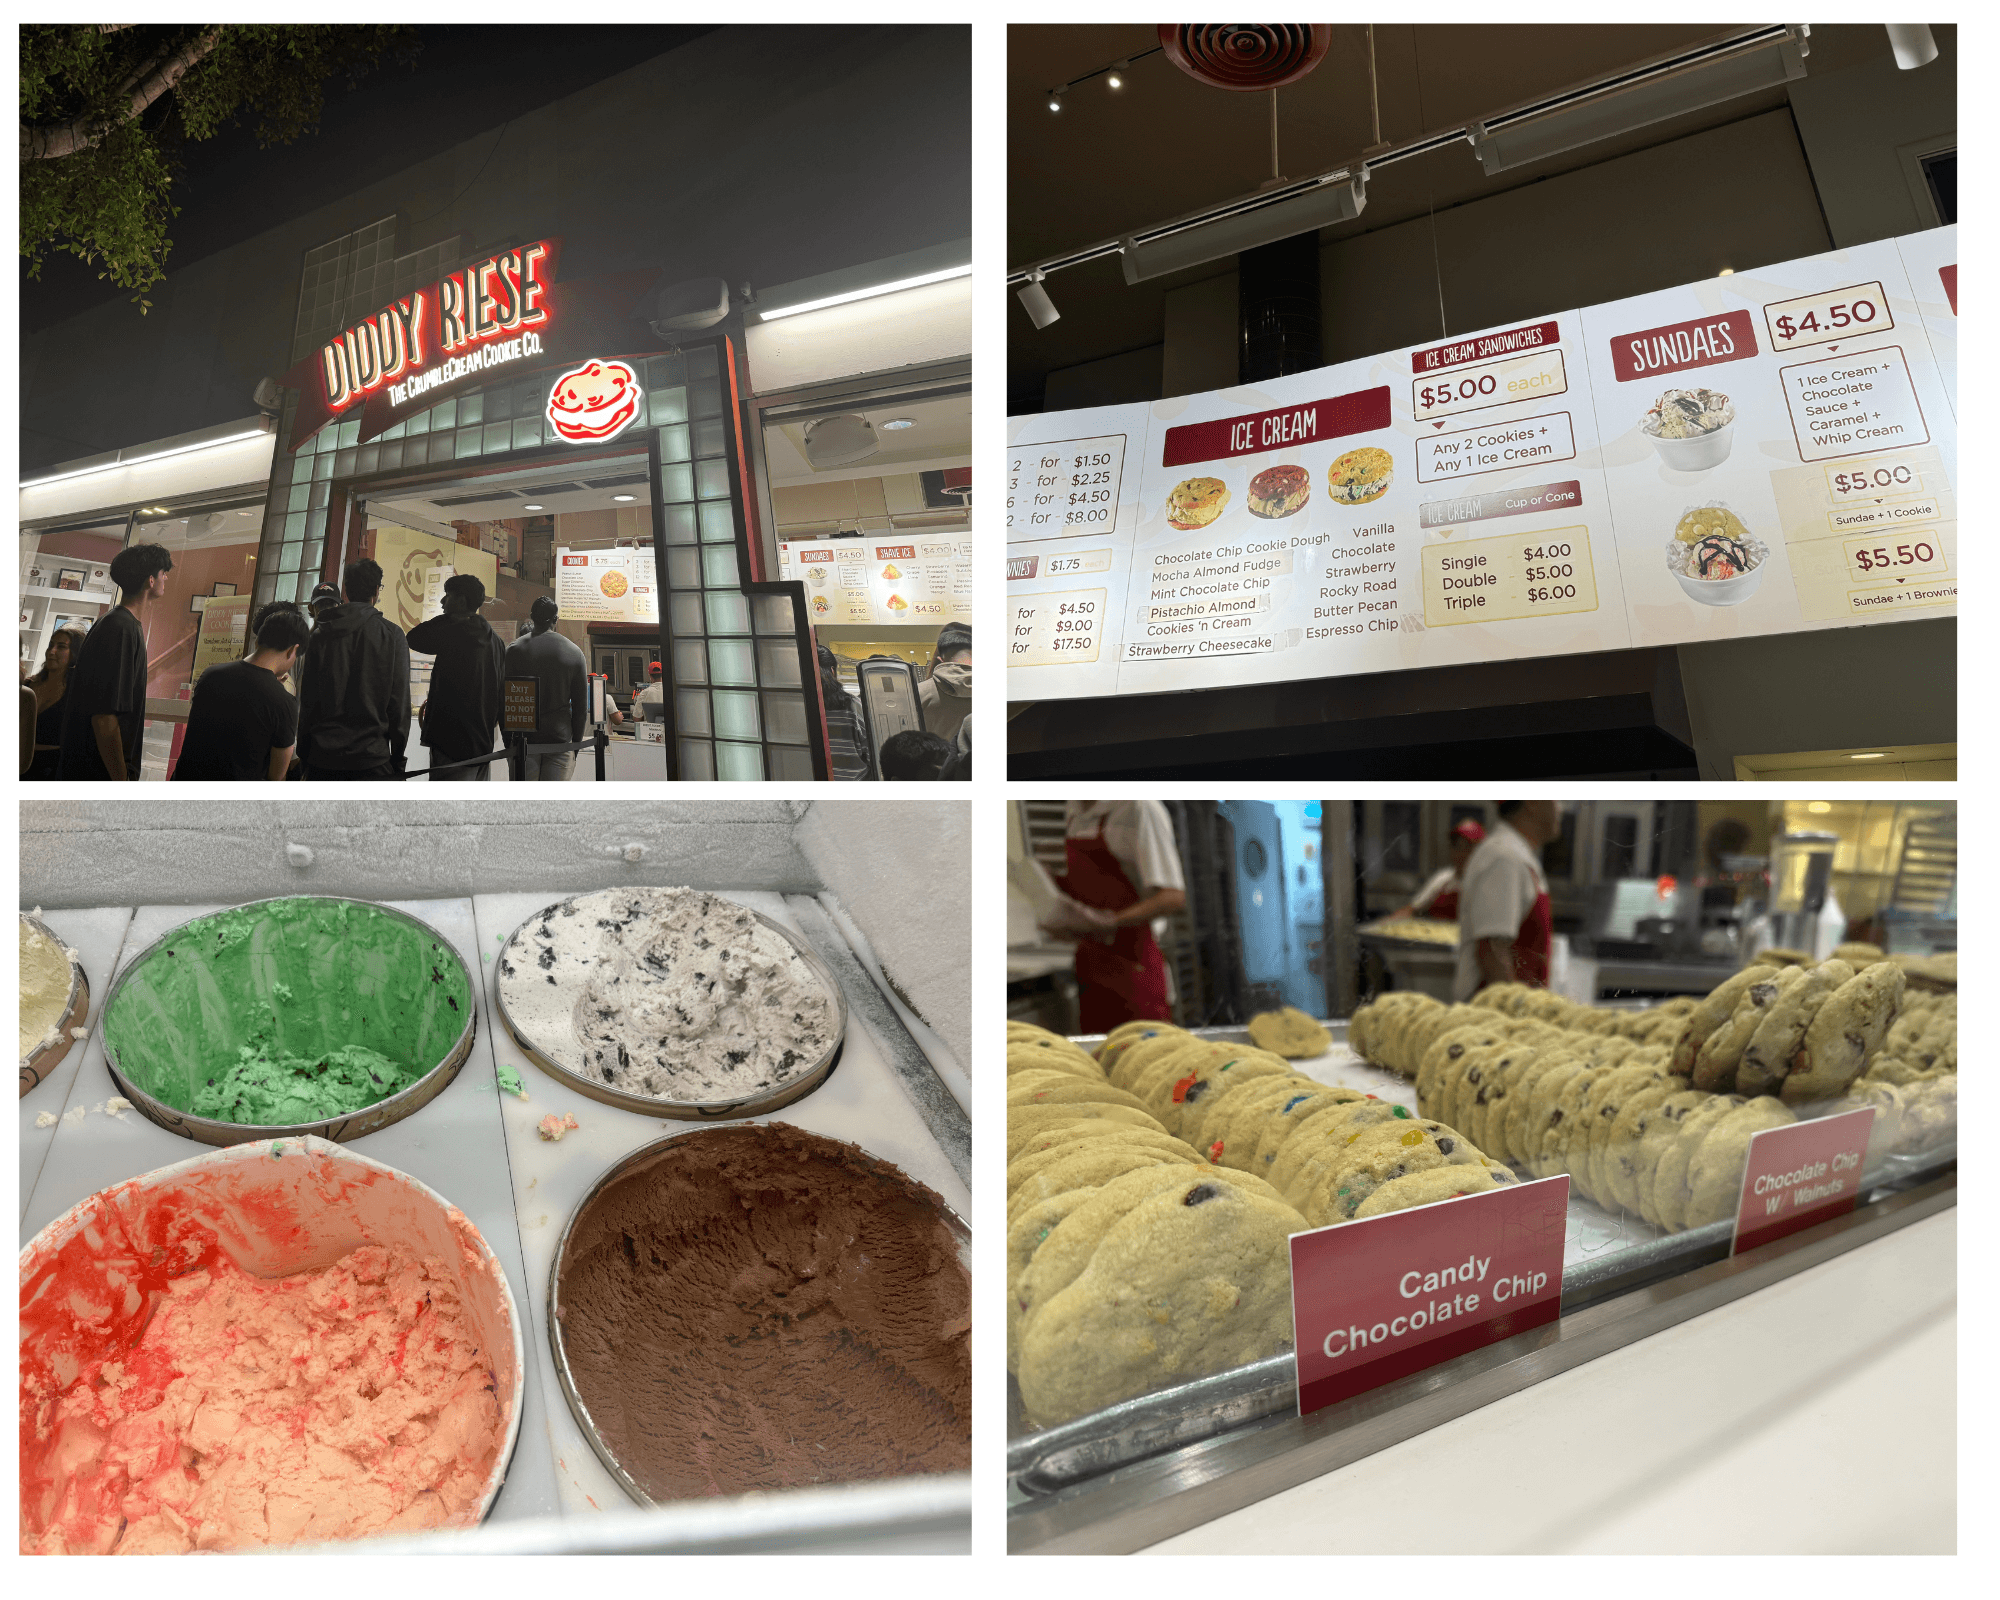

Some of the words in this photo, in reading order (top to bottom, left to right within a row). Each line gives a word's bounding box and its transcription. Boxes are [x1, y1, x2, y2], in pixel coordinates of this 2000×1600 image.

[321, 291, 424, 409] DIDDY
[439, 242, 547, 351] RIESE
[1776, 300, 1876, 340] $4.50
[1426, 350, 1440, 368] ICE
[1443, 342, 1475, 362] CREAM
[1478, 328, 1543, 356] SANDWICHES
[1630, 322, 1735, 372] SUNDAES
[388, 386, 407, 407] THE
[484, 338, 522, 368] COOKIE
[1798, 378, 1802, 387] 1
[1807, 372, 1827, 385] Ice
[1831, 364, 1877, 381] Cream
[1420, 374, 1497, 409] $5.00
[1507, 372, 1552, 393] each
[1802, 380, 1873, 401] Chocolate
[1806, 401, 1848, 417] Sauce
[1230, 423, 1254, 452] ICE
[1262, 408, 1316, 446] CREAM
[1809, 413, 1868, 431] Caramel
[1433, 442, 1461, 456] Any
[1464, 438, 1473, 450] 2
[1477, 428, 1534, 448] Cookies
[1813, 432, 1852, 447] Whip
[1855, 423, 1904, 440] Cream
[1013, 460, 1022, 472] 2
[1040, 457, 1060, 468] for
[1074, 454, 1110, 468] $1.50
[1434, 458, 1462, 473] Any
[1467, 456, 1471, 467] 1
[1478, 452, 1498, 465] Ice
[1504, 444, 1552, 461] Cream
[1010, 478, 1018, 490] 3
[1037, 475, 1057, 487] for
[1072, 472, 1110, 487] $2.25
[1835, 464, 1912, 493] $5.00
[1006, 496, 1014, 508] 6
[1034, 493, 1054, 506] for
[1069, 490, 1110, 506] $4.50
[1505, 498, 1528, 512] Cup
[1530, 496, 1542, 504] or
[1545, 491, 1575, 503] Cone
[1031, 512, 1051, 525] for
[1065, 509, 1108, 525] $8.00
[1428, 507, 1443, 524] ICE
[1447, 500, 1482, 521] CREAM
[1836, 511, 1874, 525] Sundae
[1894, 505, 1931, 518] Cookie
[1353, 523, 1395, 539] Vanilla
[805, 552, 829, 561] SUNDAES
[881, 548, 900, 558] SHAVE
[902, 548, 912, 557] ICE
[1155, 549, 1212, 566] Chocolate
[1216, 545, 1242, 562] Chip
[1246, 539, 1286, 554] Cookie
[1290, 532, 1330, 552] Dough
[1332, 542, 1396, 559] Chocolate
[1441, 554, 1487, 573] Single
[1524, 543, 1571, 562] $4.00
[1855, 542, 1934, 571] $5.50
[1051, 558, 1080, 572] $1.75
[1085, 560, 1104, 568] each
[1152, 569, 1190, 583] Mocha
[1194, 563, 1239, 578] Almond
[1243, 557, 1281, 575] Fudge
[1325, 560, 1396, 580] Strawberry
[1151, 588, 1176, 600] Mint
[1180, 581, 1239, 597] Chocolate
[1243, 576, 1270, 592] Chip
[1320, 583, 1360, 598] Rocky
[1363, 579, 1396, 592] Road
[1443, 573, 1497, 590] Double
[1526, 564, 1573, 582] $5.00
[1151, 604, 1205, 619] Pistachio
[1209, 599, 1256, 613] Almond
[1314, 603, 1355, 618] Butter
[1358, 599, 1398, 613] Pecan
[1444, 594, 1486, 611] Triple
[1528, 585, 1575, 602] $6.00
[1853, 592, 1894, 606] Sundae
[1906, 591, 1911, 600] 1
[1018, 608, 1035, 619] for
[1059, 602, 1094, 615] $4.50
[1015, 625, 1032, 637] for
[1056, 620, 1092, 633] $9.00
[1147, 622, 1194, 636] Cookies
[1211, 616, 1251, 630] Cream
[1306, 622, 1363, 640] Espresso
[1367, 617, 1399, 634] Chip
[1012, 642, 1030, 654] for
[1053, 638, 1091, 651] $17.50
[1128, 642, 1195, 658] Strawberry
[1199, 637, 1272, 653] Cheesecake
[1752, 1161, 1827, 1197] Chocolate
[1832, 1151, 1858, 1176] Chip
[1793, 1180, 1843, 1206] Walnuts
[1399, 1251, 1492, 1298] Candy
[1322, 1290, 1480, 1359] Chocolate
[1492, 1269, 1548, 1303] Chip
